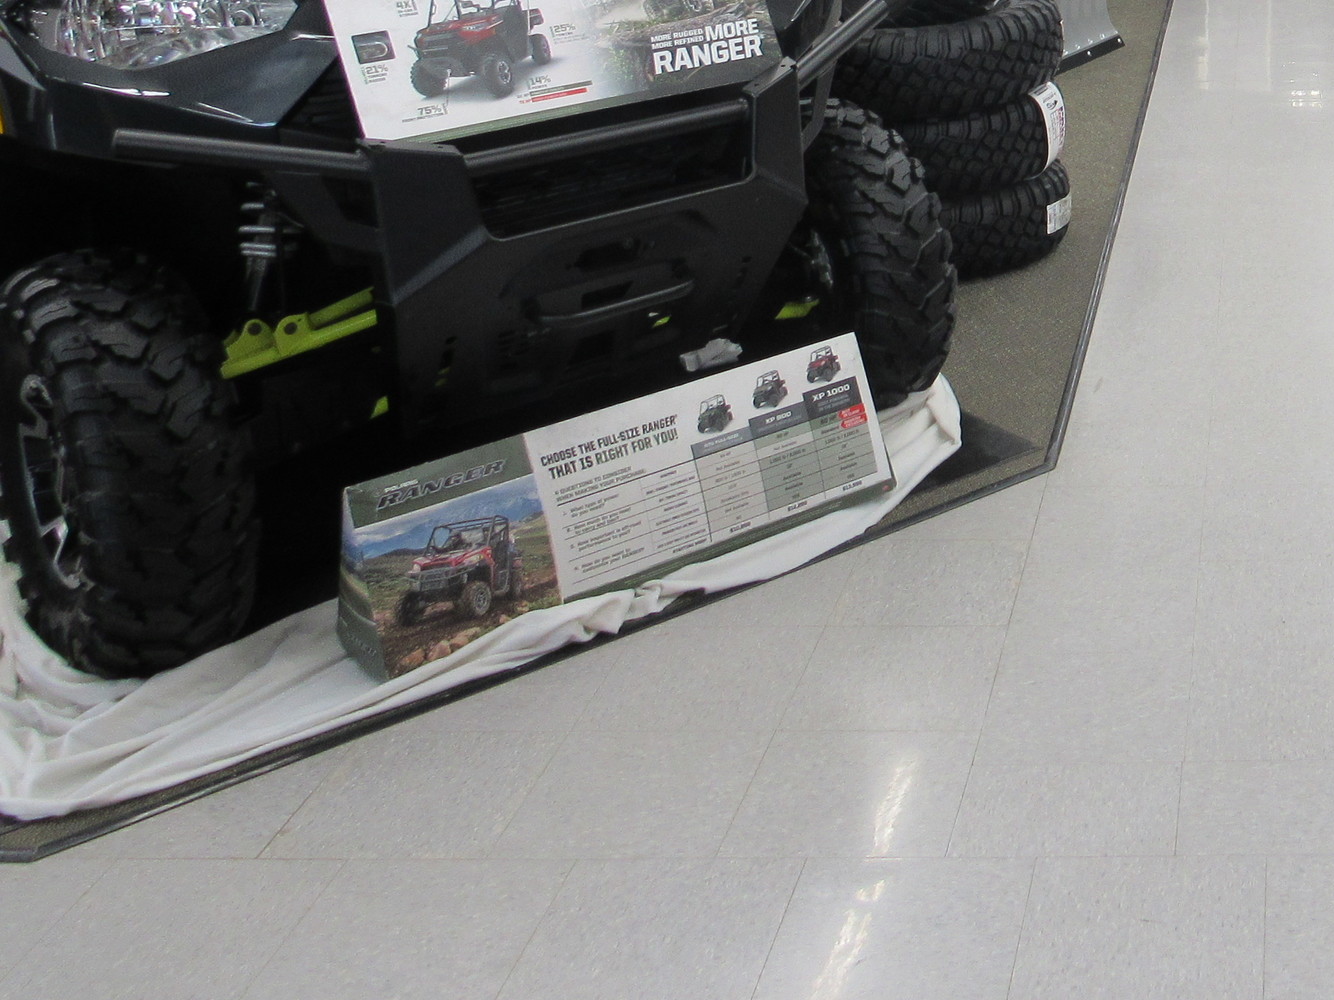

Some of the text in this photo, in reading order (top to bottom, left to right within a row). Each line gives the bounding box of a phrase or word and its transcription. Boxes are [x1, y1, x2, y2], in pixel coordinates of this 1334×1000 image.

[554, 24, 576, 33] 25%
[651, 18, 759, 42] MORE RUGGED MORE
[651, 36, 704, 50] MORE REFINED
[653, 36, 762, 74] RANGER
[418, 105, 442, 115] 75%
[812, 384, 850, 402] XP 1000
[540, 414, 678, 467] CHOOSE THE FULL-SIZE RANGER
[548, 428, 679, 480] THAT IS RIGHT FOR YOU!
[376, 459, 505, 511] RANGER
